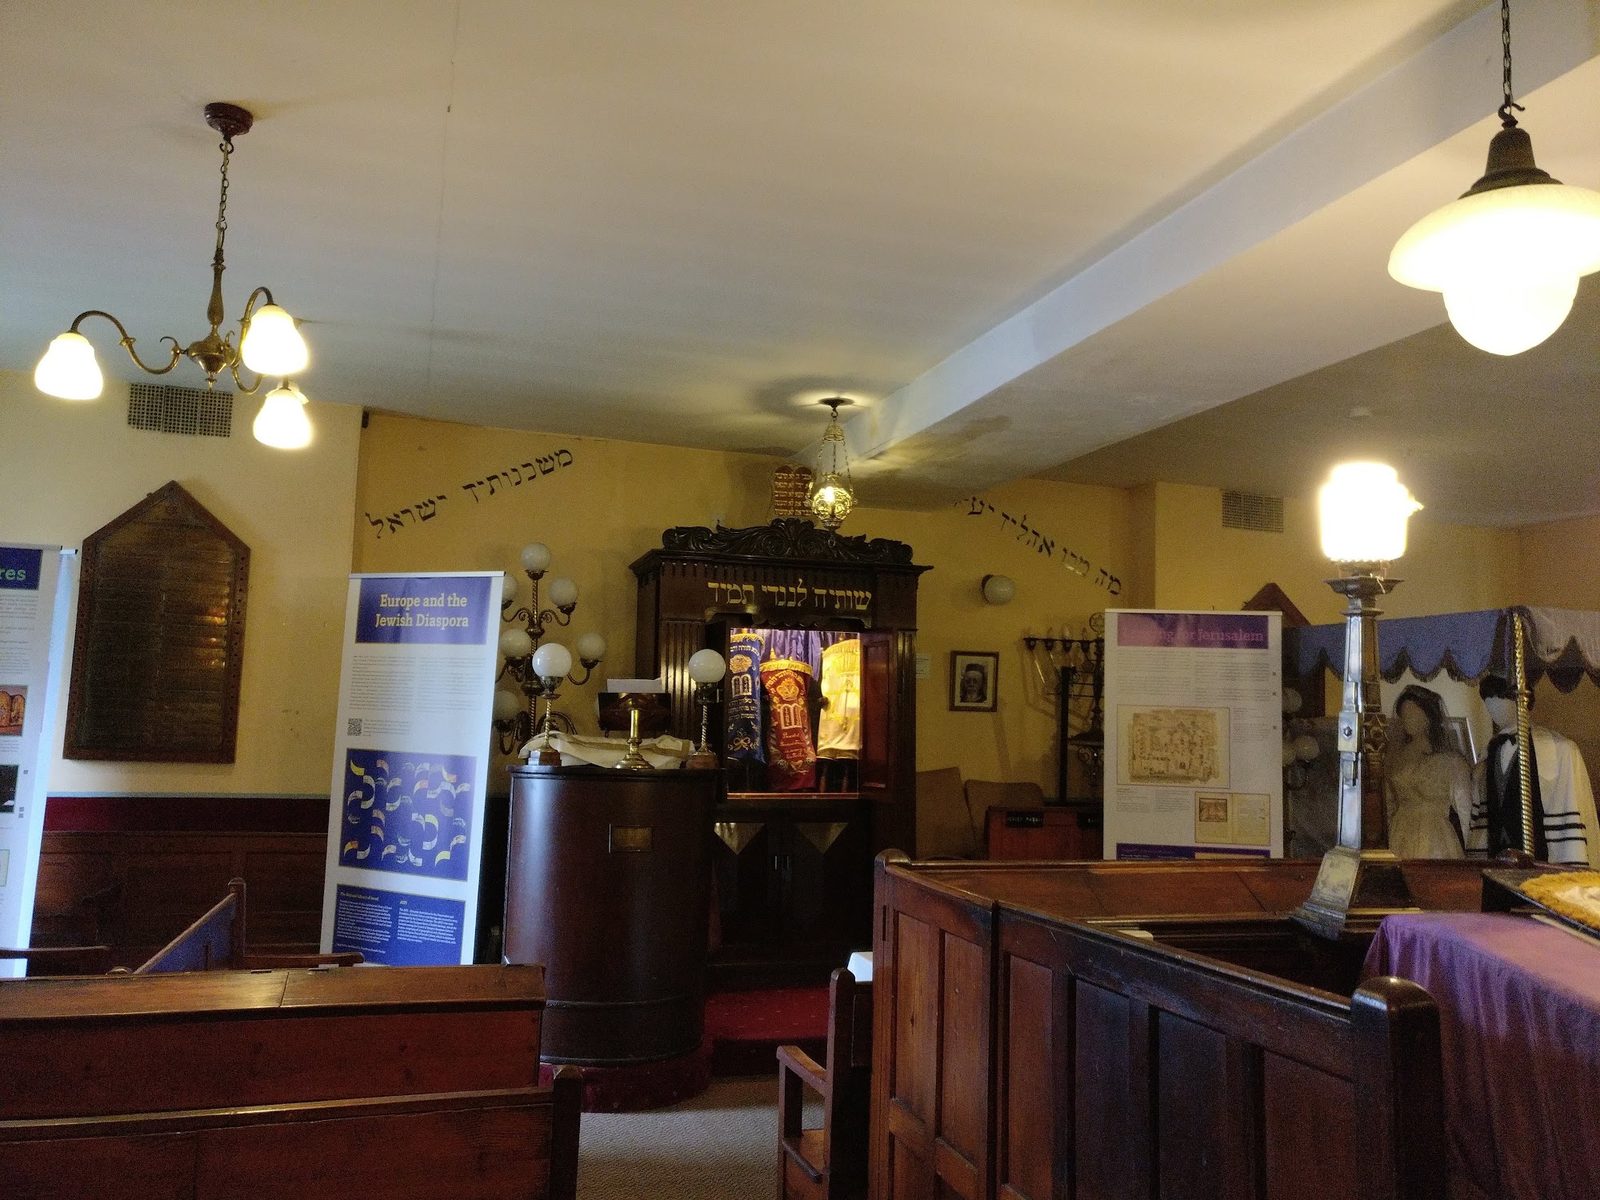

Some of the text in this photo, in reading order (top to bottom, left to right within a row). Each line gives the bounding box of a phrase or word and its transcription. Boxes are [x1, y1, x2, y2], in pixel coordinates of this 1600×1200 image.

[365, 449, 573, 539] משכנותיך ישראל
[761, 578, 808, 607] לנגדי
[1094, 568, 1121, 595] מה
[380, 592, 468, 611] Europe and the
[707, 582, 755, 605] תמיד
[375, 612, 469, 630] Jewish Diaspora
[1198, 628, 1264, 642] Jerusalem
